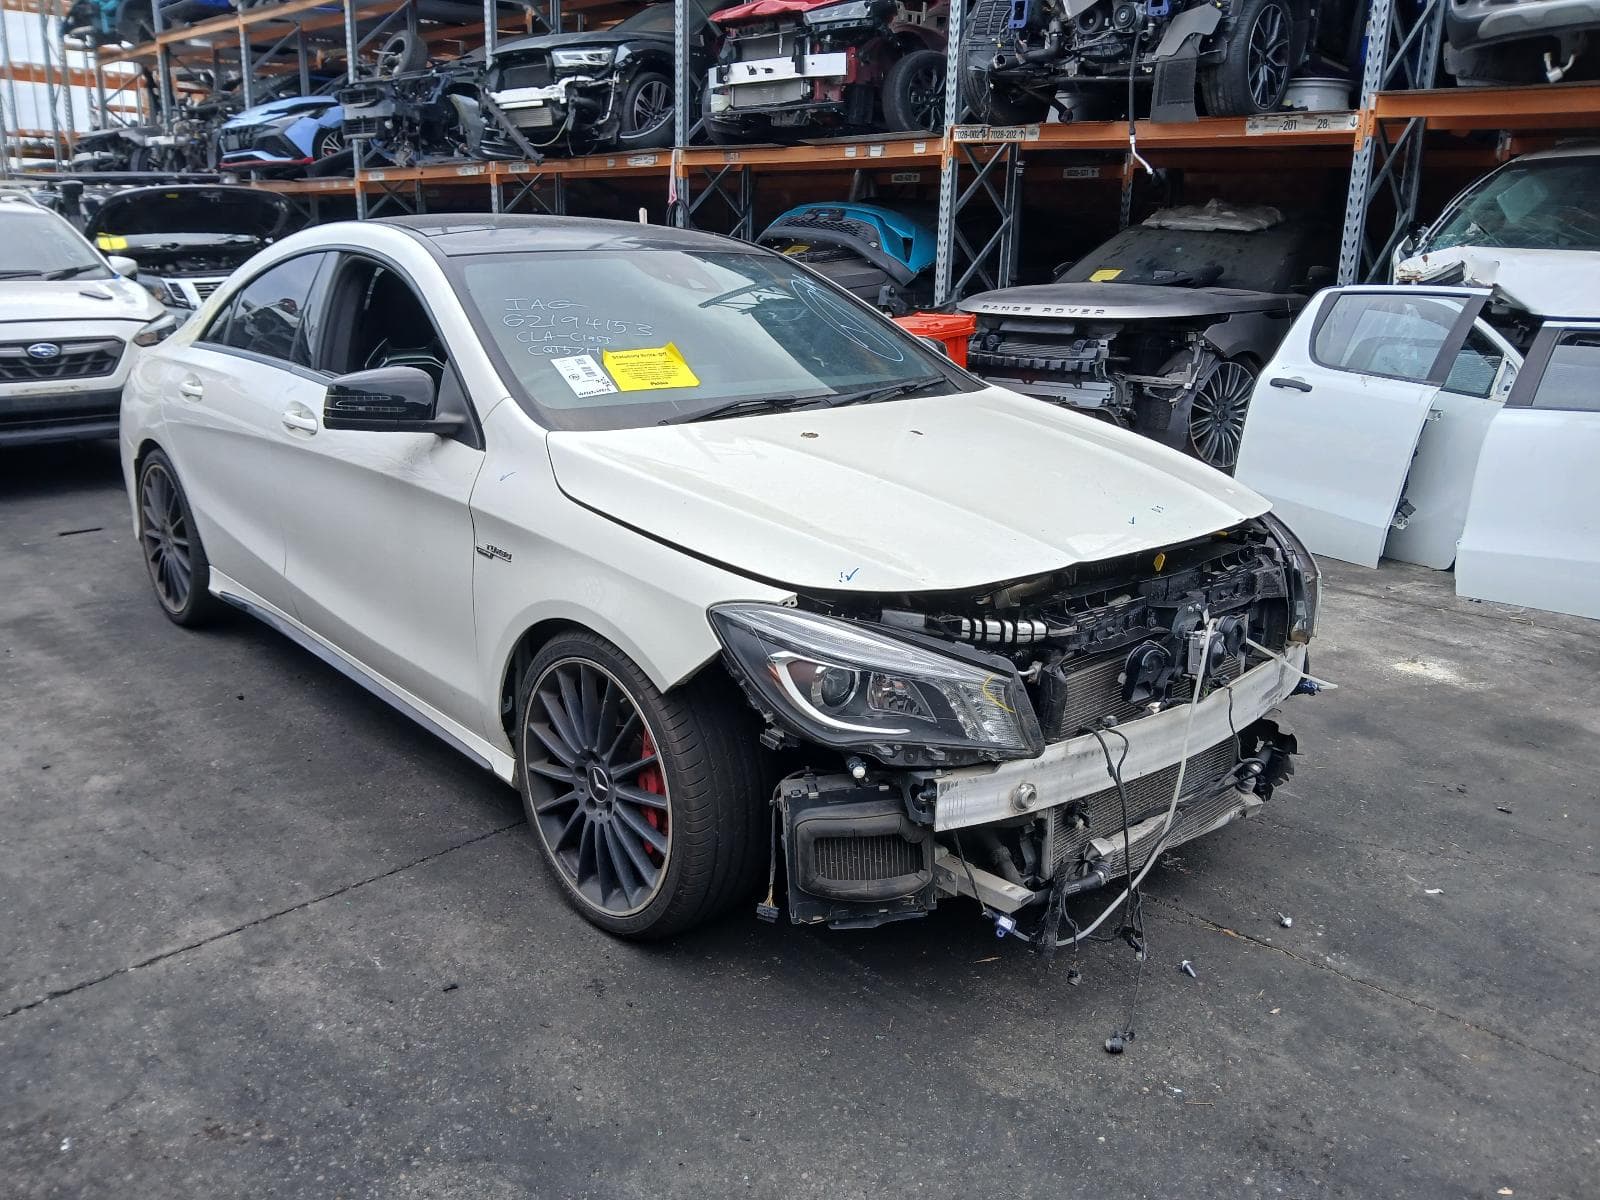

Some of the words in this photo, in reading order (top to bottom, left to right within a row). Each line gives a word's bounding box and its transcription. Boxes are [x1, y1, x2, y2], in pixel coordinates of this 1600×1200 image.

[504, 298, 588, 311] IAG
[982, 304, 1032, 313] RANGE
[1042, 307, 1105, 315] ROVER
